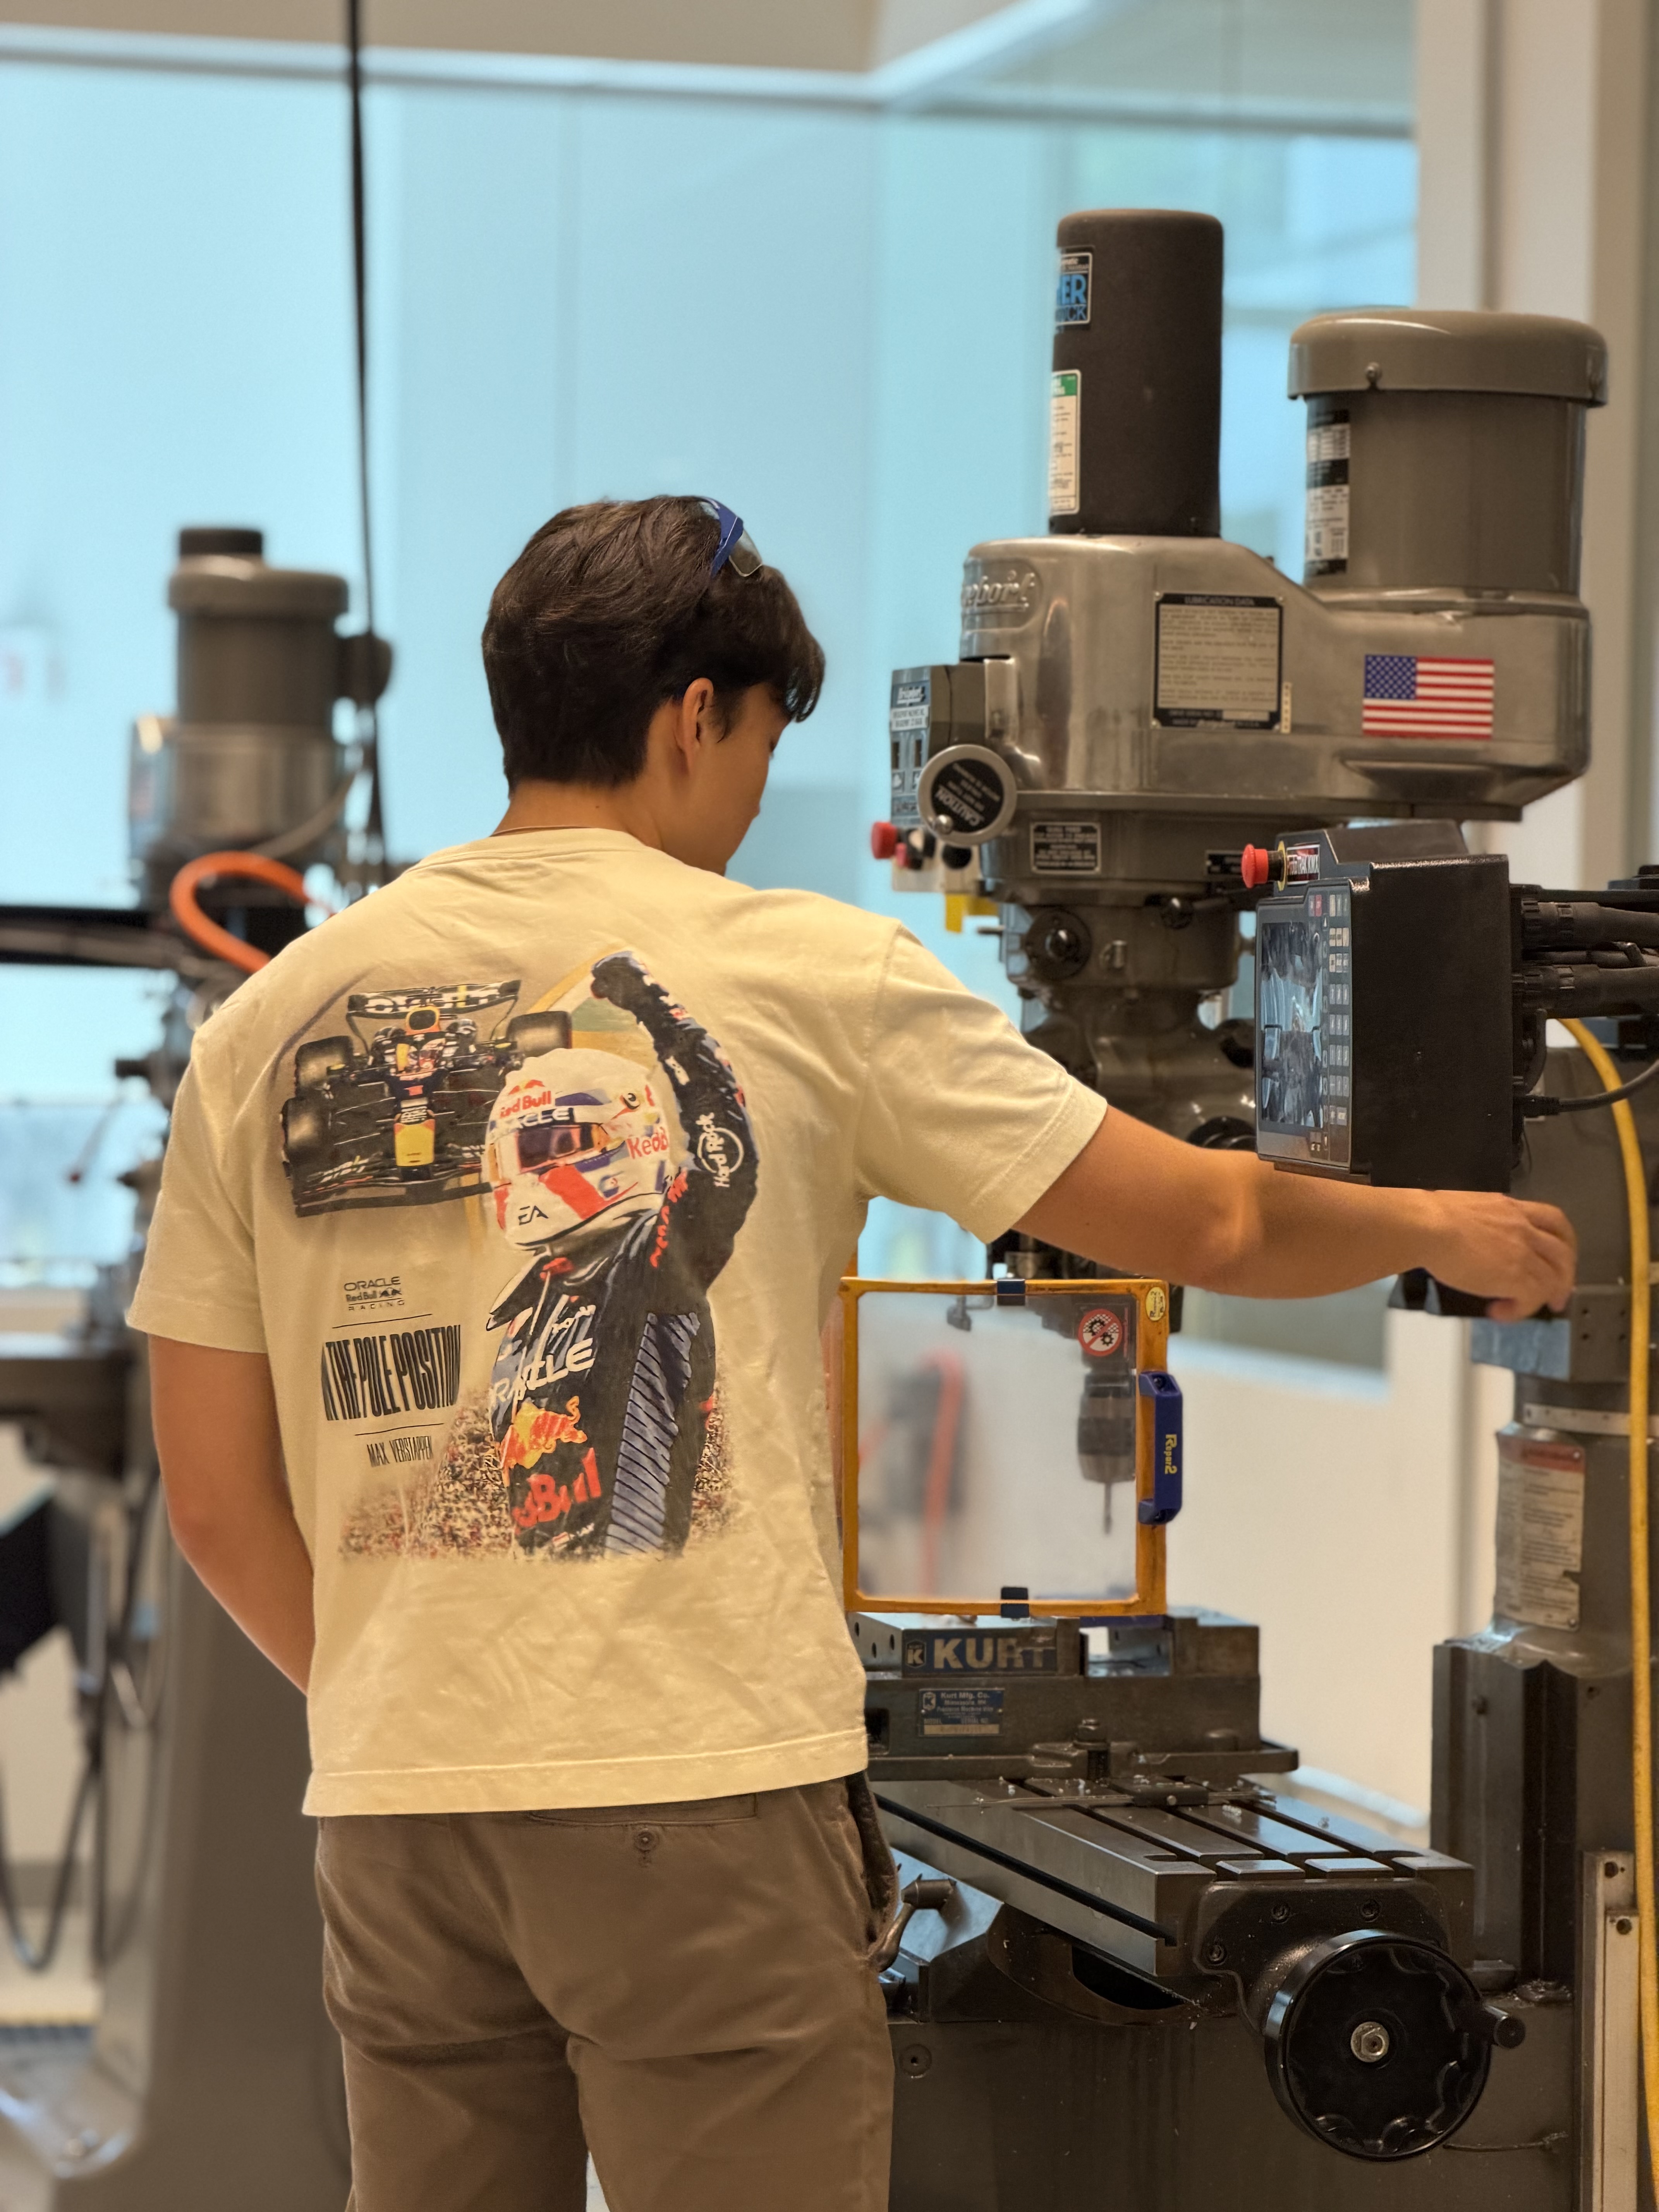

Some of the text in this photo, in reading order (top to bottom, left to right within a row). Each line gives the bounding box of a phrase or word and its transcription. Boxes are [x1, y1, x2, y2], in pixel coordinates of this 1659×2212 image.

[522, 1091, 551, 1110] Bull
[519, 1205, 549, 1226] EA
[344, 1276, 401, 1291] ORACLE
[345, 1290, 377, 1302] Red Bull
[353, 1335, 401, 1418] POLE
